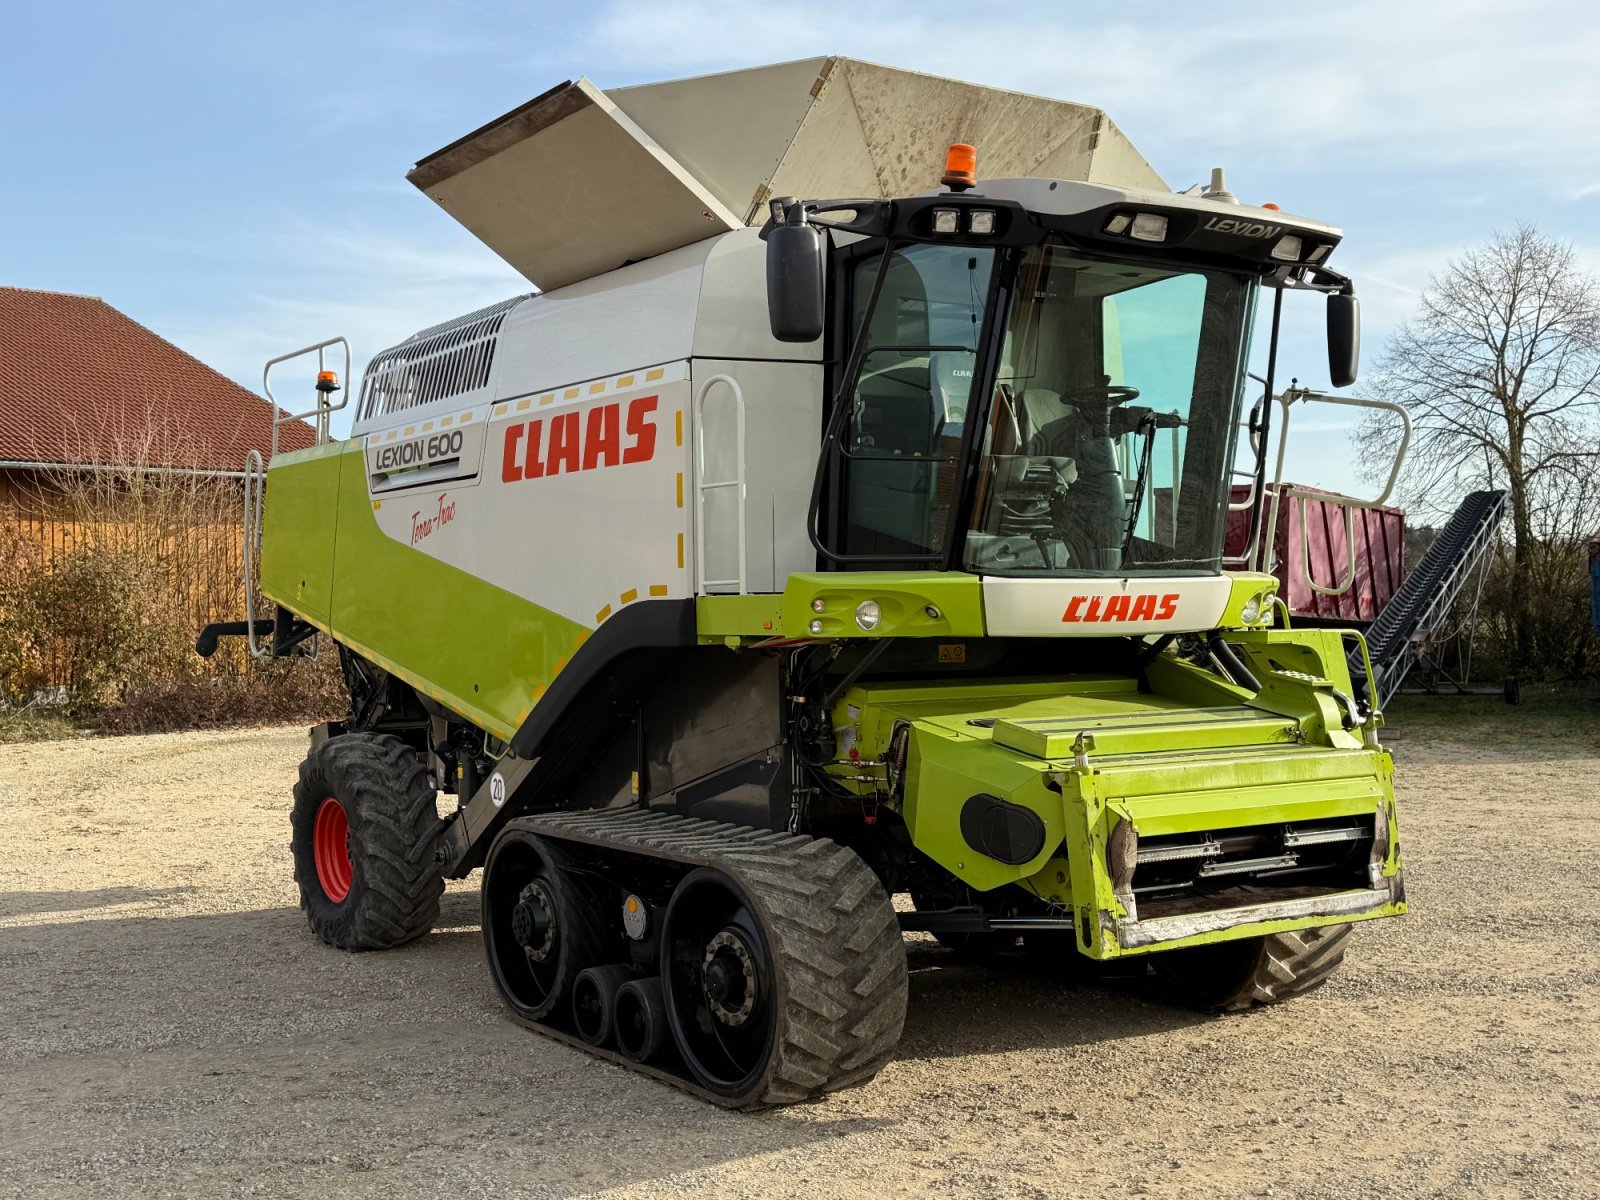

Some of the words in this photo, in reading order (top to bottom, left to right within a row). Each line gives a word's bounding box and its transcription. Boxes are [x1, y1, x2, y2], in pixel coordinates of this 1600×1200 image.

[1204, 216, 1281, 239] LEXION
[376, 439, 424, 470] LEXION
[427, 430, 463, 458] 600
[502, 394, 659, 484] CLAAS
[1061, 594, 1180, 622] CLAAS
[493, 778, 503, 802] 20
